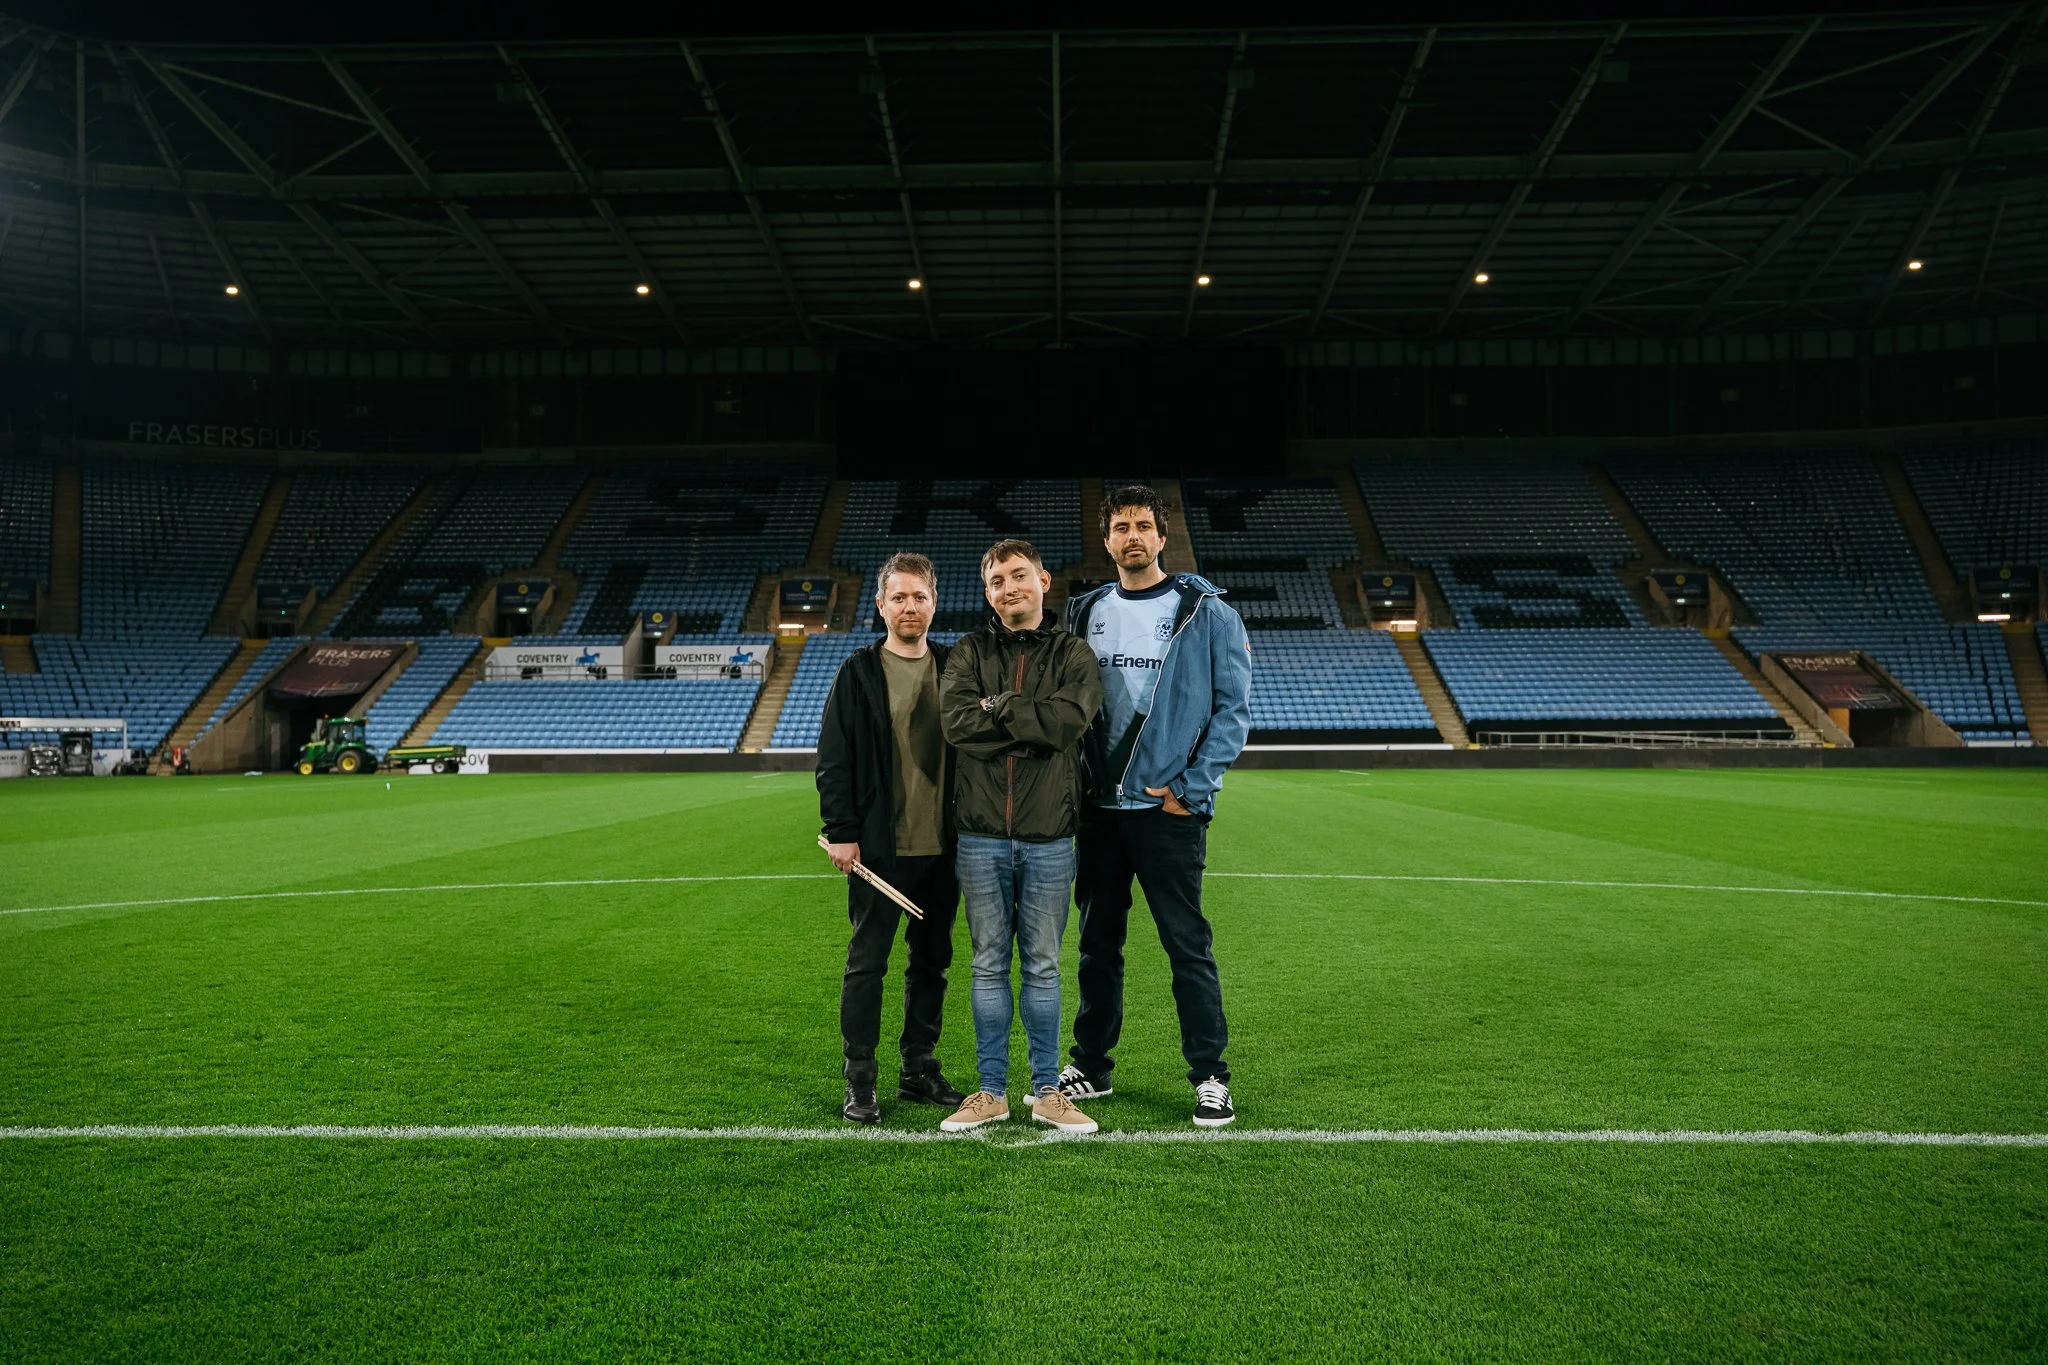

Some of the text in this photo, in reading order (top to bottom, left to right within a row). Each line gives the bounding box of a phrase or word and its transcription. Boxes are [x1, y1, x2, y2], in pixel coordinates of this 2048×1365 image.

[314, 648, 393, 660] FRASERS
[517, 654, 569, 664] COVENTRY
[669, 653, 722, 663] COVENTRY
[308, 656, 351, 668] PLUS
[1111, 653, 1163, 670] Enem
